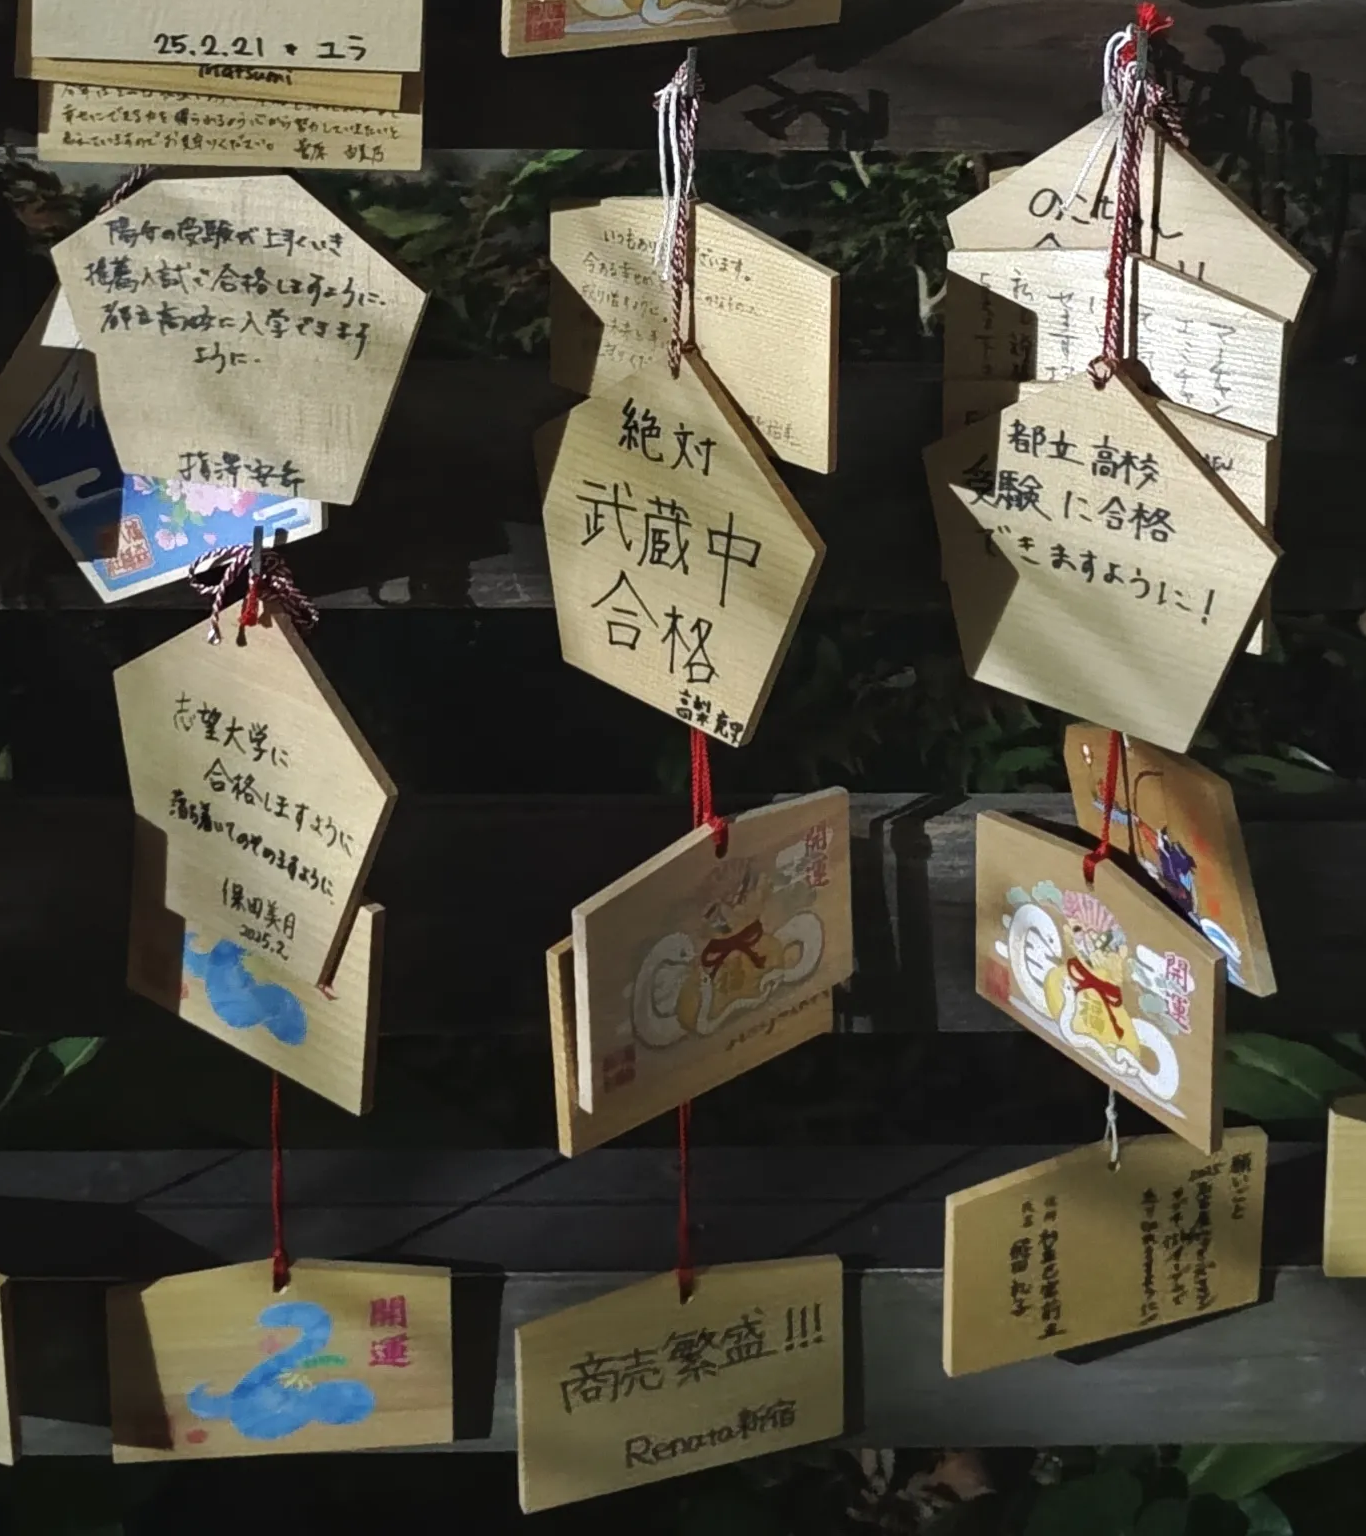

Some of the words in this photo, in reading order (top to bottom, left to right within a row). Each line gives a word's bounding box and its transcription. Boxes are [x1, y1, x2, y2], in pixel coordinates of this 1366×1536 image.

[617, 396, 718, 477] 絶対
[575, 478, 763, 609] 武蔵中
[590, 568, 720, 684] 合格
[172, 691, 290, 770] 志望大学に
[368, 1295, 411, 1369] 開運
